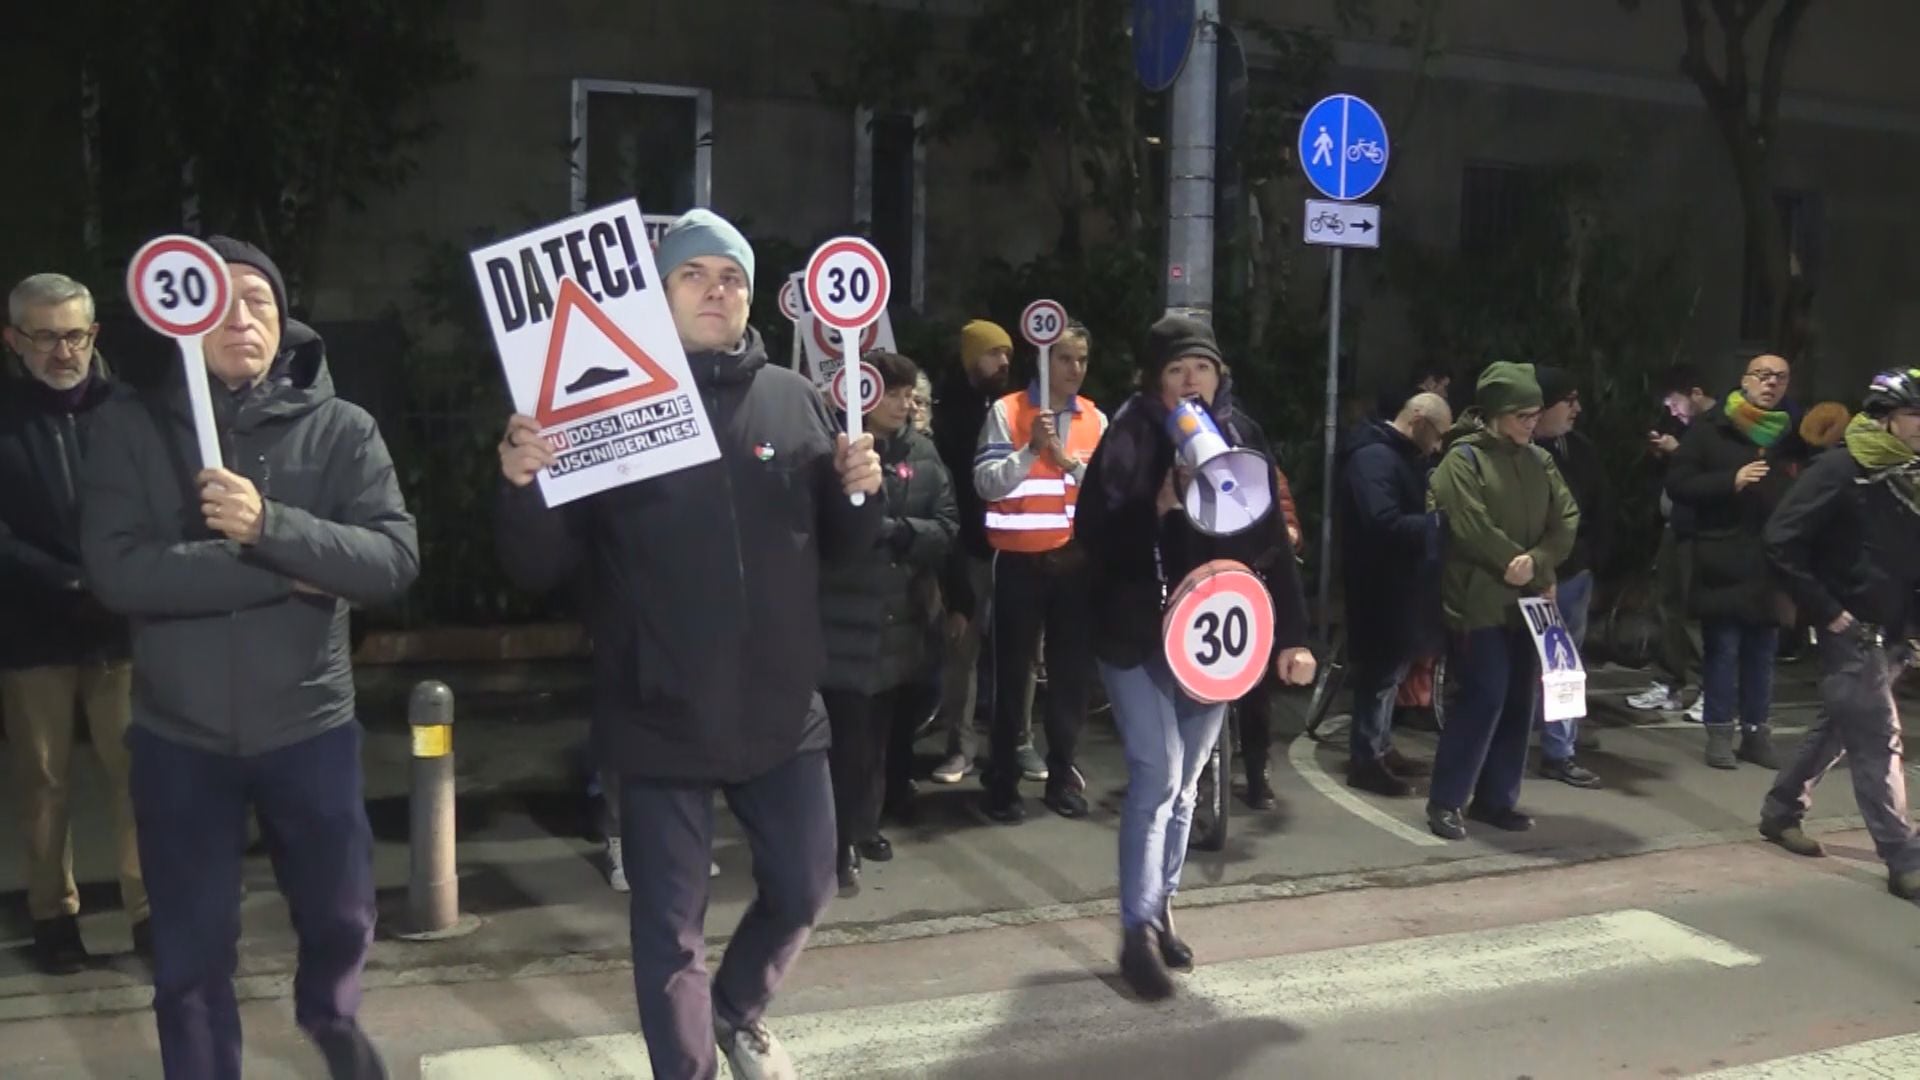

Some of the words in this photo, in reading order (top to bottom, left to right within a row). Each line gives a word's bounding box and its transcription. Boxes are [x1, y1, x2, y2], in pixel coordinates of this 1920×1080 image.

[154, 267, 207, 309] 30
[486, 215, 647, 333] DATECI
[827, 266, 870, 304] 30
[1033, 314, 1057, 332] 30
[568, 420, 623, 445] DOSSI,
[623, 400, 678, 430] RIALZI
[680, 397, 693, 414] E
[549, 445, 614, 477] CUSCINI
[614, 420, 699, 458] BERLINESI
[1193, 605, 1248, 666] 30
